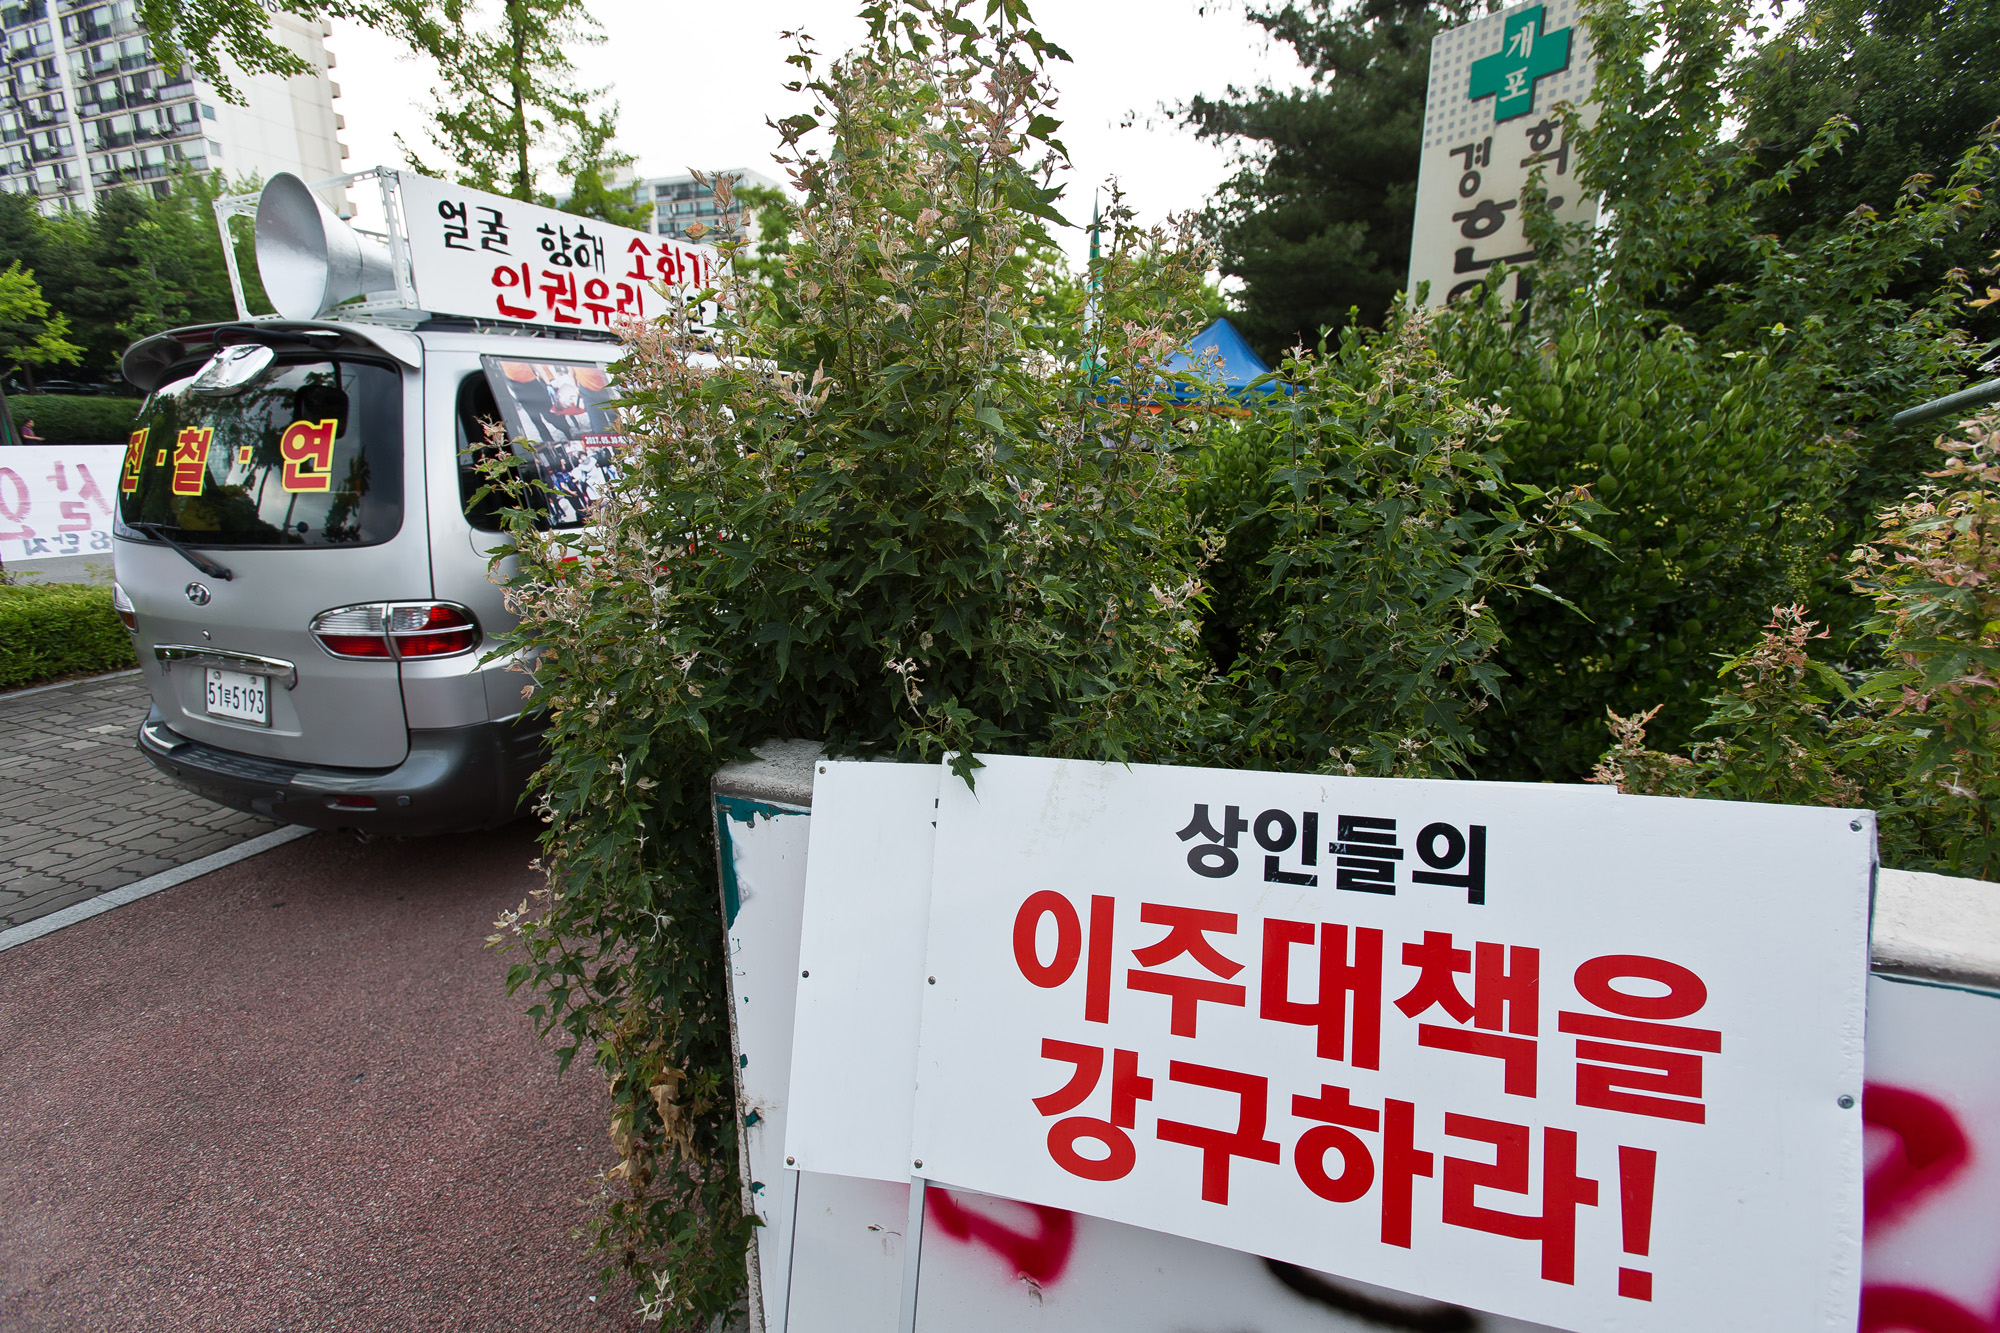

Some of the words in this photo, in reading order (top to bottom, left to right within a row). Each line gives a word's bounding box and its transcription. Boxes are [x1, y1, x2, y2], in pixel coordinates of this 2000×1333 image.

[1499, 20, 1536, 102] 개포
[1449, 117, 1569, 198] 경희
[437, 199, 513, 257] 얼굴
[536, 222, 606, 275] 향해
[625, 237, 710, 290] 소화기
[208, 681, 264, 715] 51루5193
[1174, 803, 1487, 906] 상인들의
[1012, 889, 1722, 1125] 이주대책을
[1031, 1037, 1657, 1302] 강구하라!
